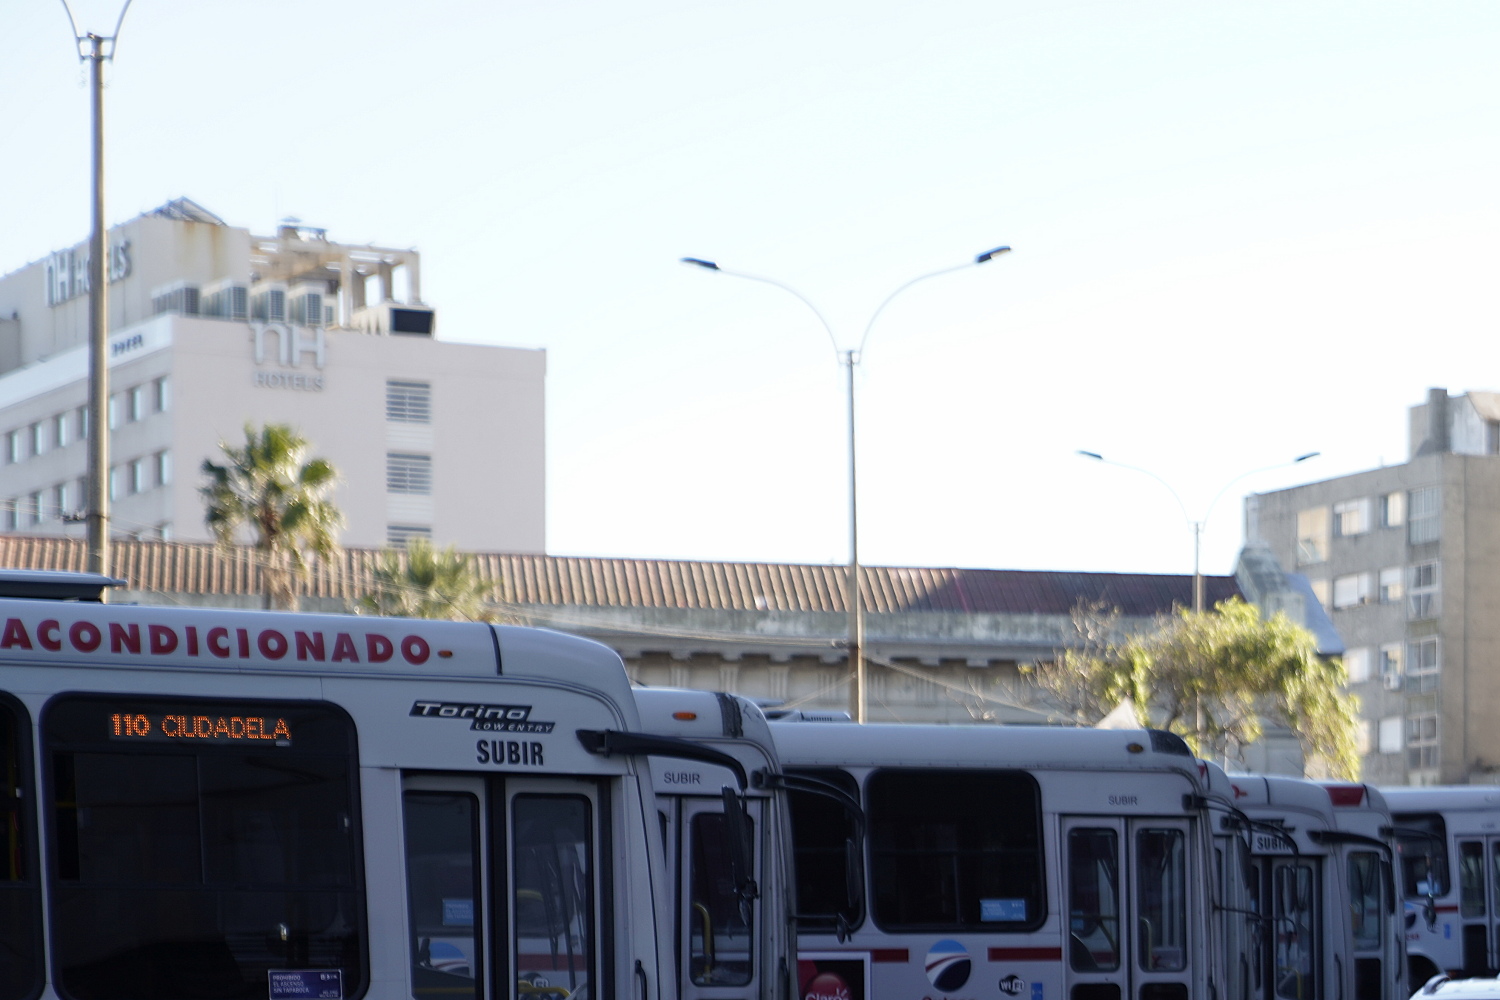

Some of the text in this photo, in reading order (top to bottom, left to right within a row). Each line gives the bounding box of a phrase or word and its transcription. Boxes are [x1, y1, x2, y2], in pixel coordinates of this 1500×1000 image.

[253, 372, 326, 392] HOTELS
[0, 617, 431, 666] ACONDICIONADO
[415, 702, 526, 720] Torino
[110, 713, 292, 740] 110 CIUDADELA
[475, 722, 552, 733] LOW ENTRY
[476, 739, 545, 766] SUBIR
[663, 771, 701, 785] SUBIR
[1108, 795, 1138, 806] SUBIR
